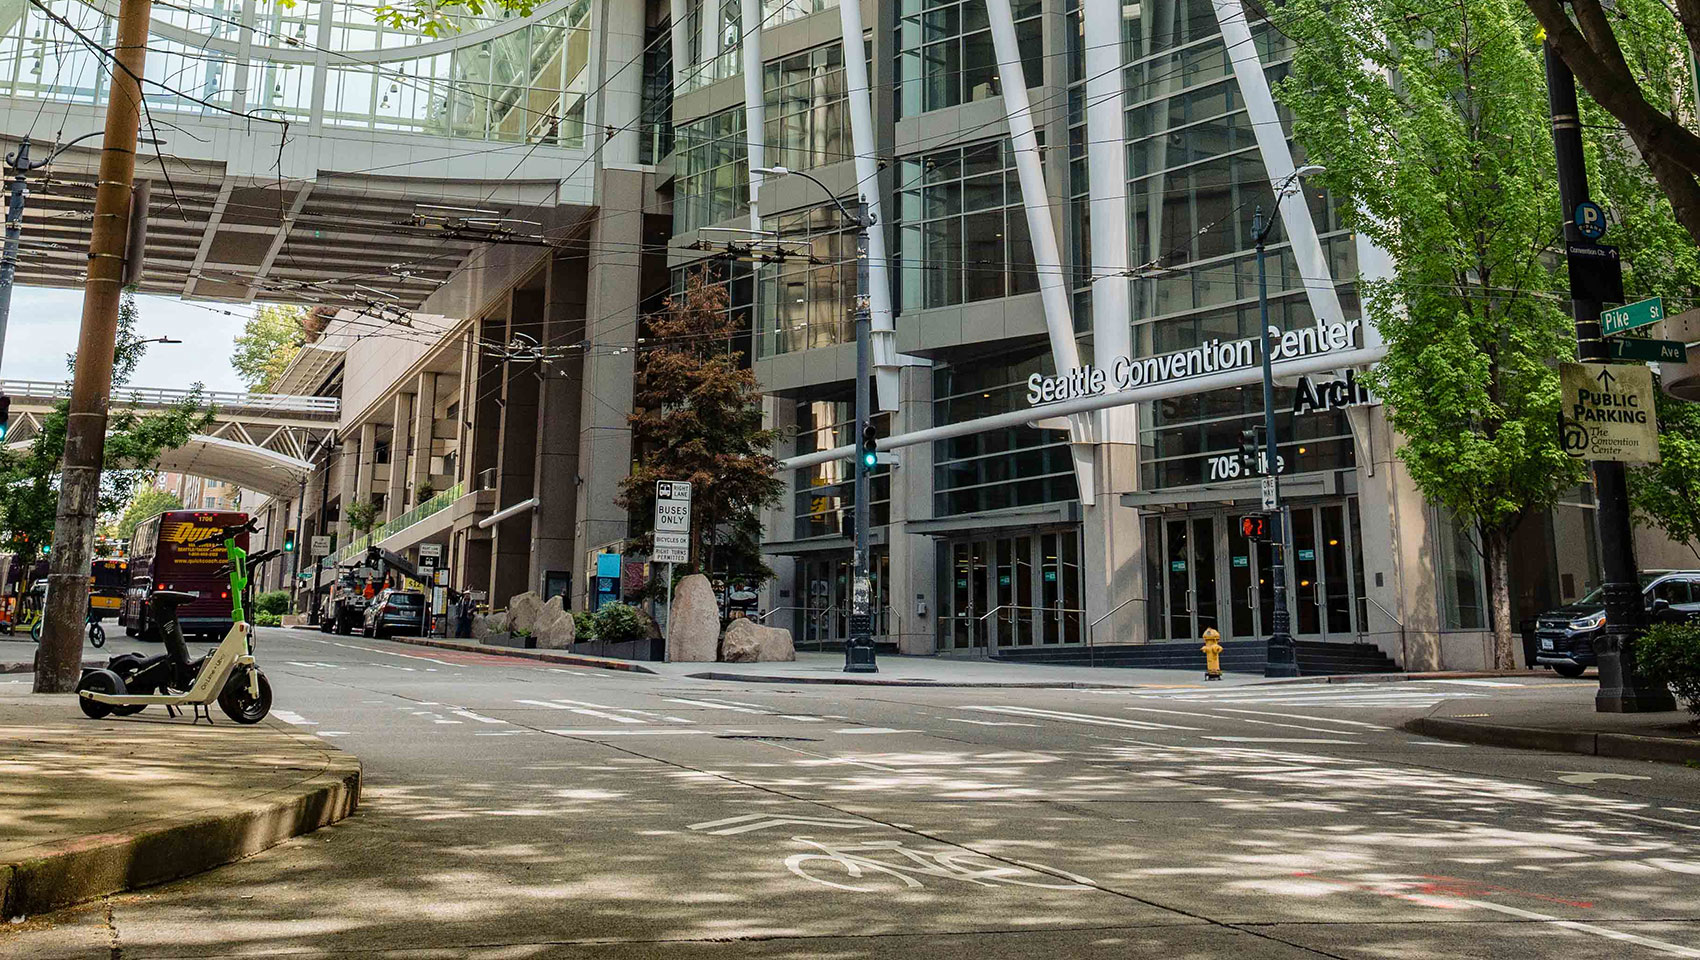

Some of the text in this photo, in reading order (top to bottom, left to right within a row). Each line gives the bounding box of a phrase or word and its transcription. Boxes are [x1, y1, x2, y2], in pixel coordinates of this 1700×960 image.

[1605, 305, 1660, 331] Pike St
[1661, 345, 1680, 358] Ave
[1026, 364, 1105, 404] Seattle
[1111, 338, 1253, 389] Convention
[1590, 427, 1608, 437] The
[1591, 435, 1639, 447] Convention
[1591, 444, 1622, 455] Center
[1208, 451, 1285, 480] 705 ike
[673, 484, 689, 492] RIGHT
[658, 506, 688, 515] BUSES
[661, 515, 684, 524] ONLY
